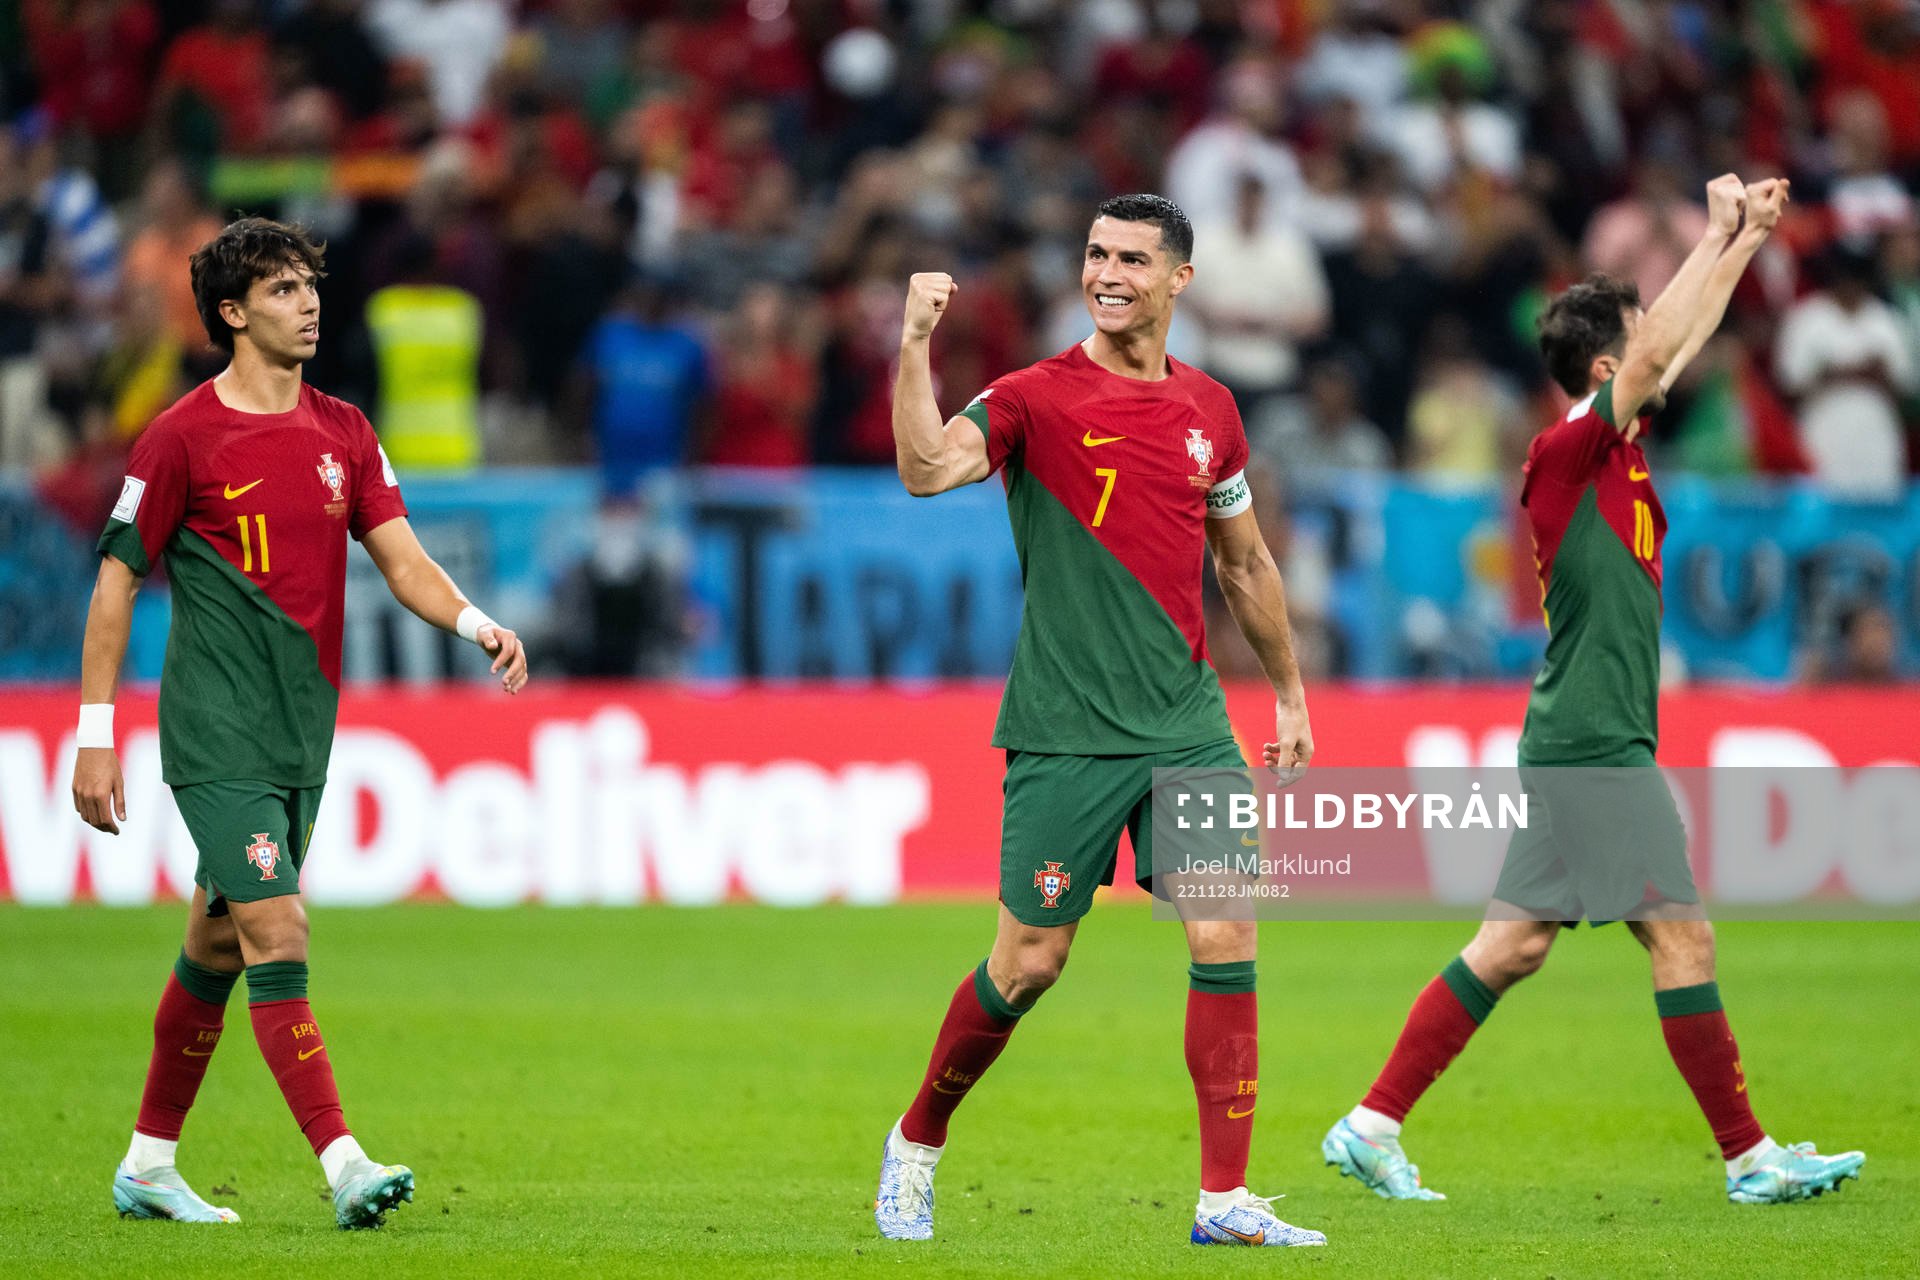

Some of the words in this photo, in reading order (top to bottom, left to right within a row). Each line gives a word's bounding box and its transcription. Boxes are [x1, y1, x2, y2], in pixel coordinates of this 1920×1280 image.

[1092, 468, 1117, 527] 7
[237, 513, 270, 573] 11
[1634, 499, 1655, 561] 10
[0, 727, 197, 909] W
[301, 703, 933, 909] Deliver
